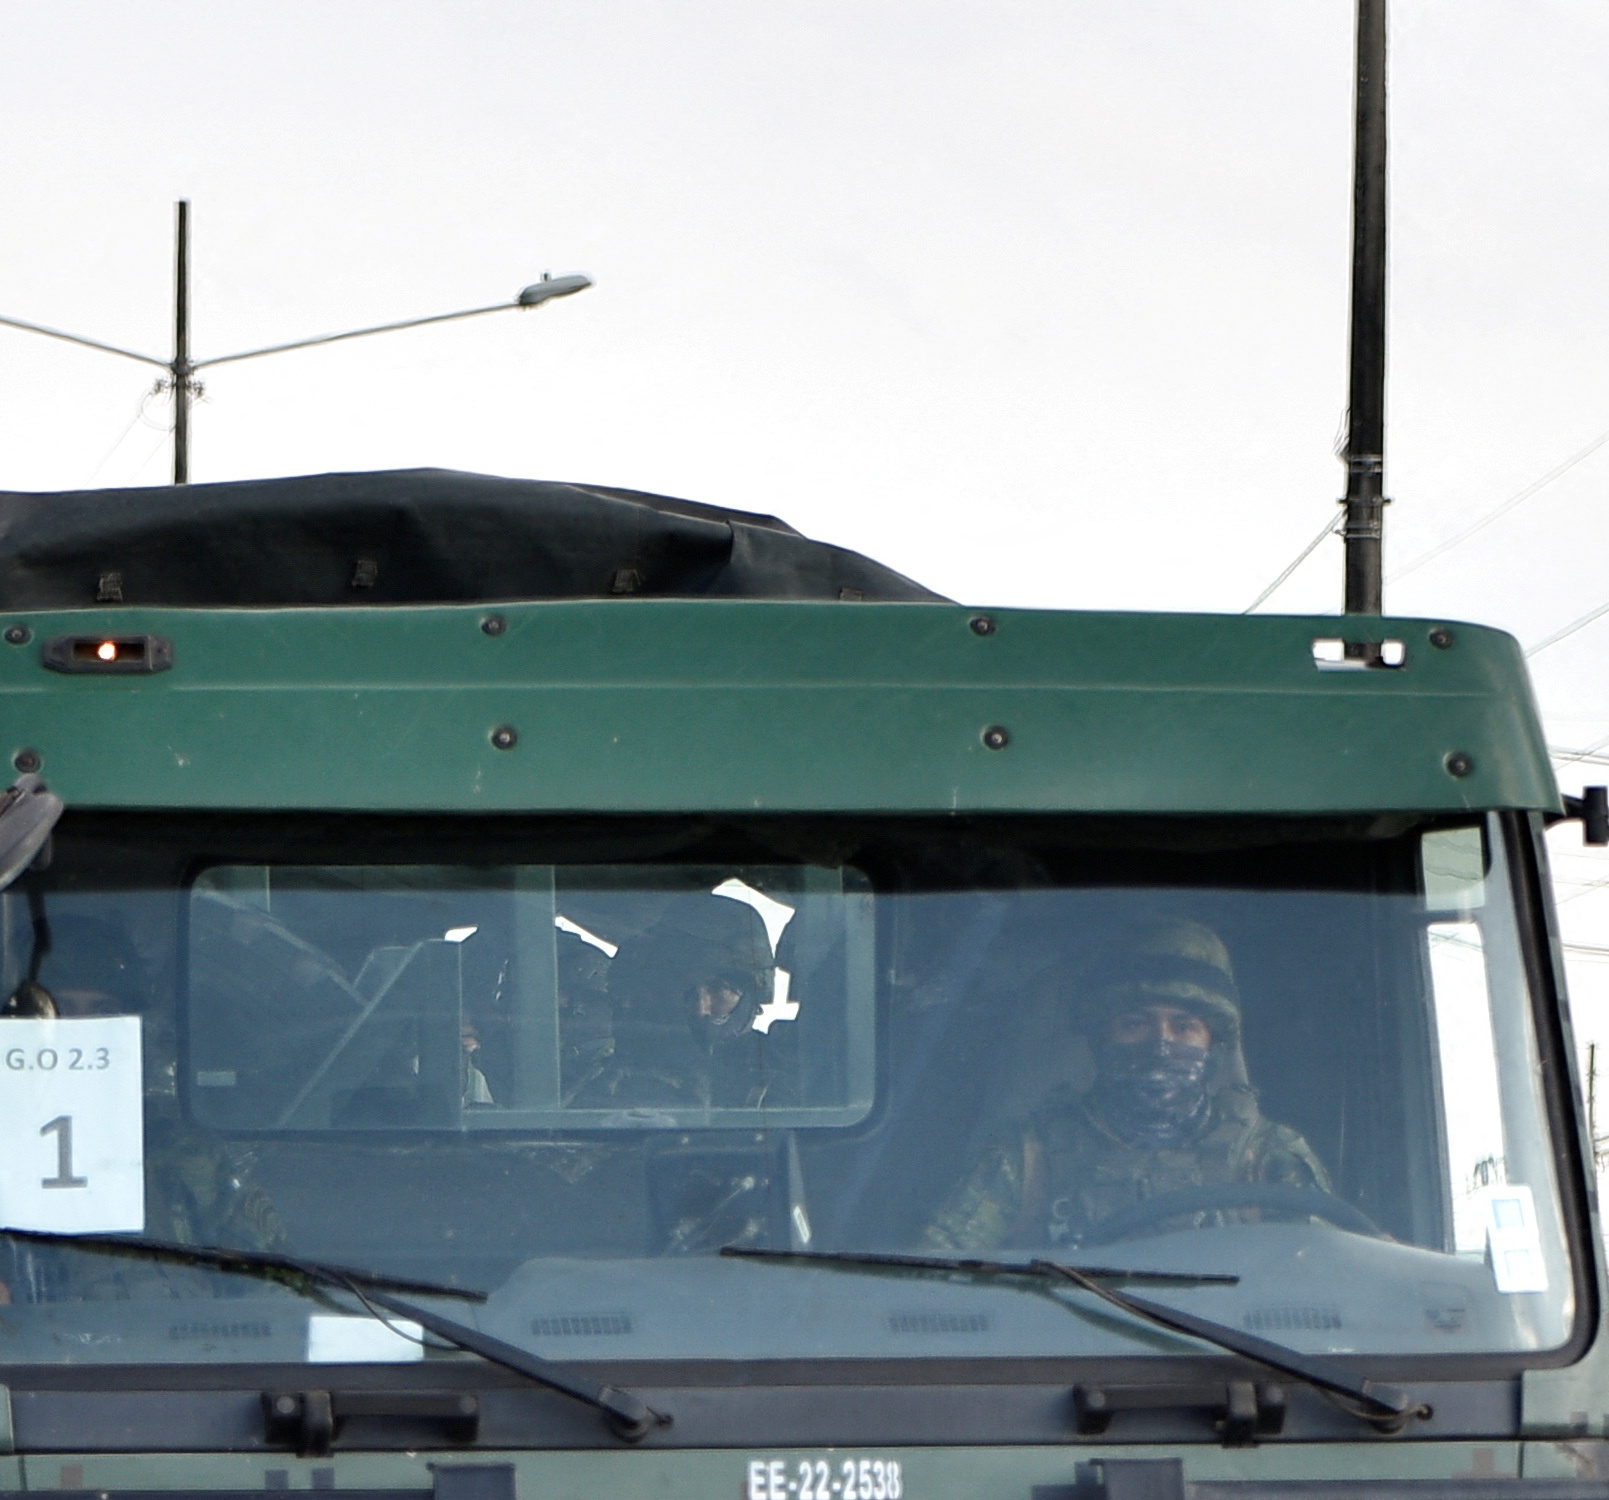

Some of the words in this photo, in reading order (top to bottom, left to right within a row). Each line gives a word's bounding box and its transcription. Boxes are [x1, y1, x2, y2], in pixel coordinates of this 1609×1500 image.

[5, 1048, 58, 1071] G.O
[68, 1047, 110, 1071] 2.3
[39, 1115, 88, 1190] 1
